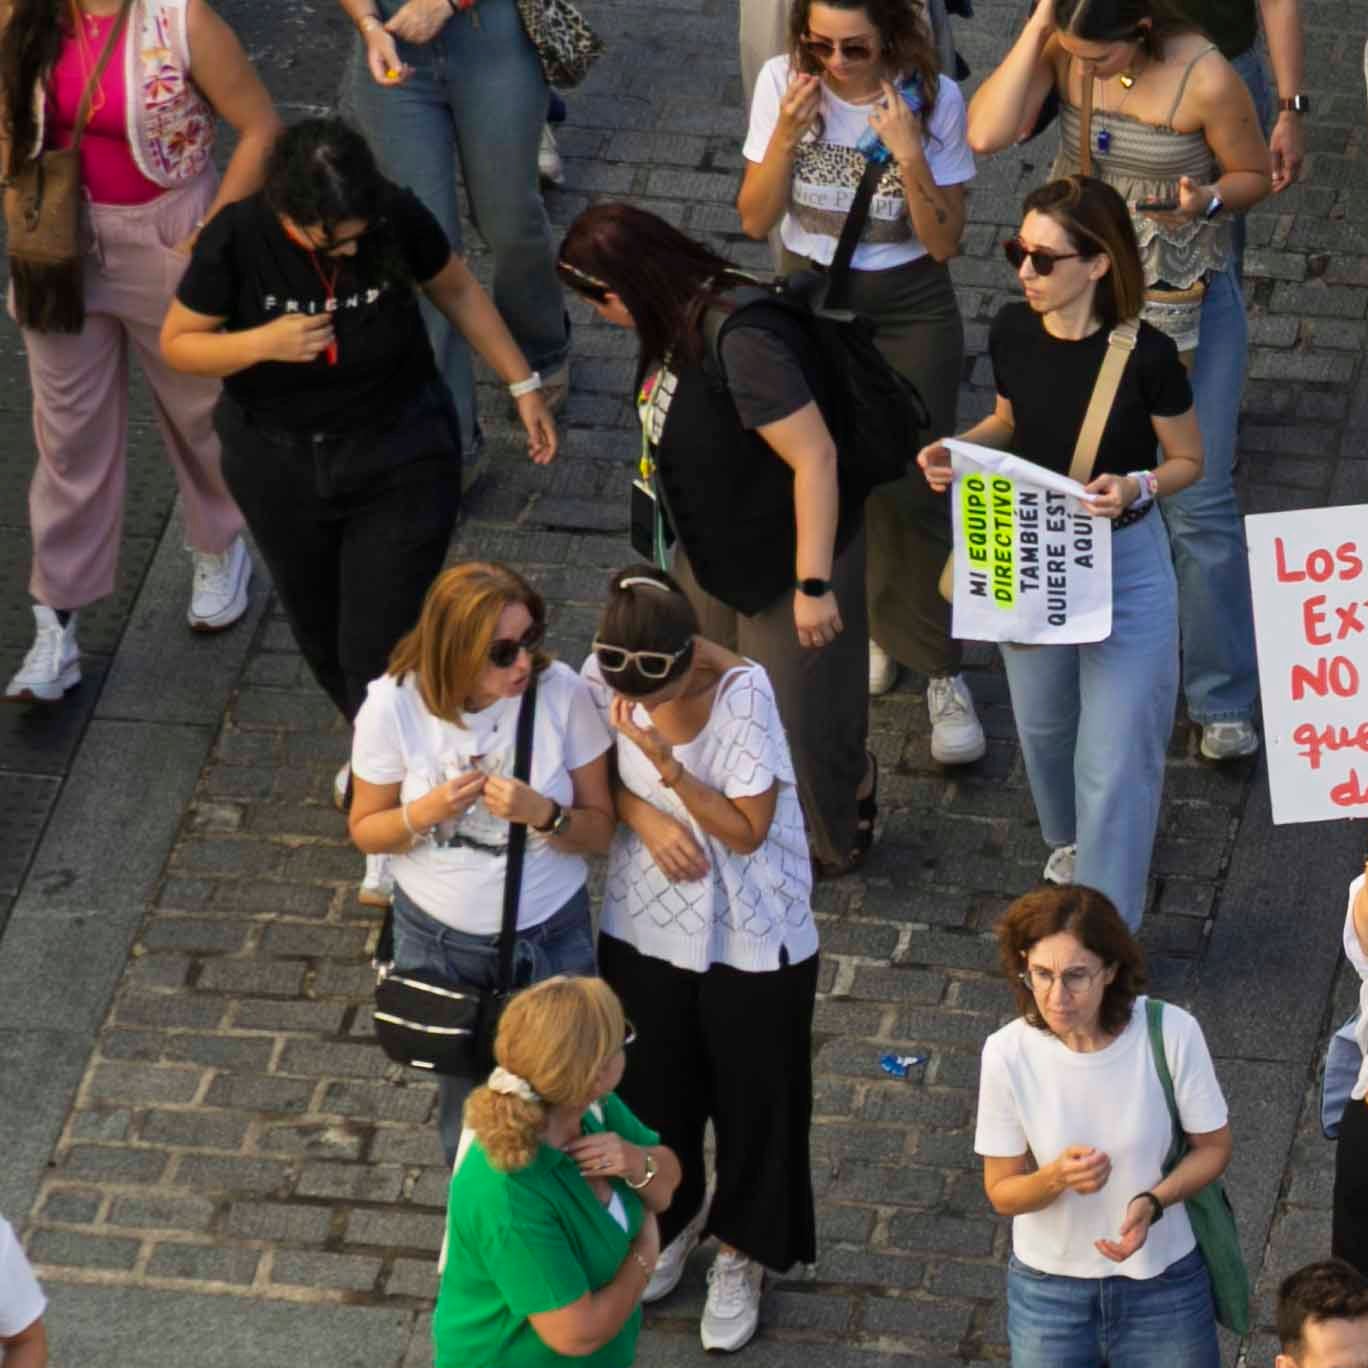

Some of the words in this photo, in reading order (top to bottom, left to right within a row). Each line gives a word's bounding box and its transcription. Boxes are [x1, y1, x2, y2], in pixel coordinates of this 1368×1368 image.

[967, 478, 987, 563] EQUIPO
[992, 479, 1014, 603] DIRECTIVO
[1014, 491, 1040, 594] TAMBIÉN
[1068, 513, 1094, 569] AQUÍ
[969, 571, 988, 598] MI
[1046, 543, 1067, 627] QUIERE
[1291, 655, 1360, 701] NO
